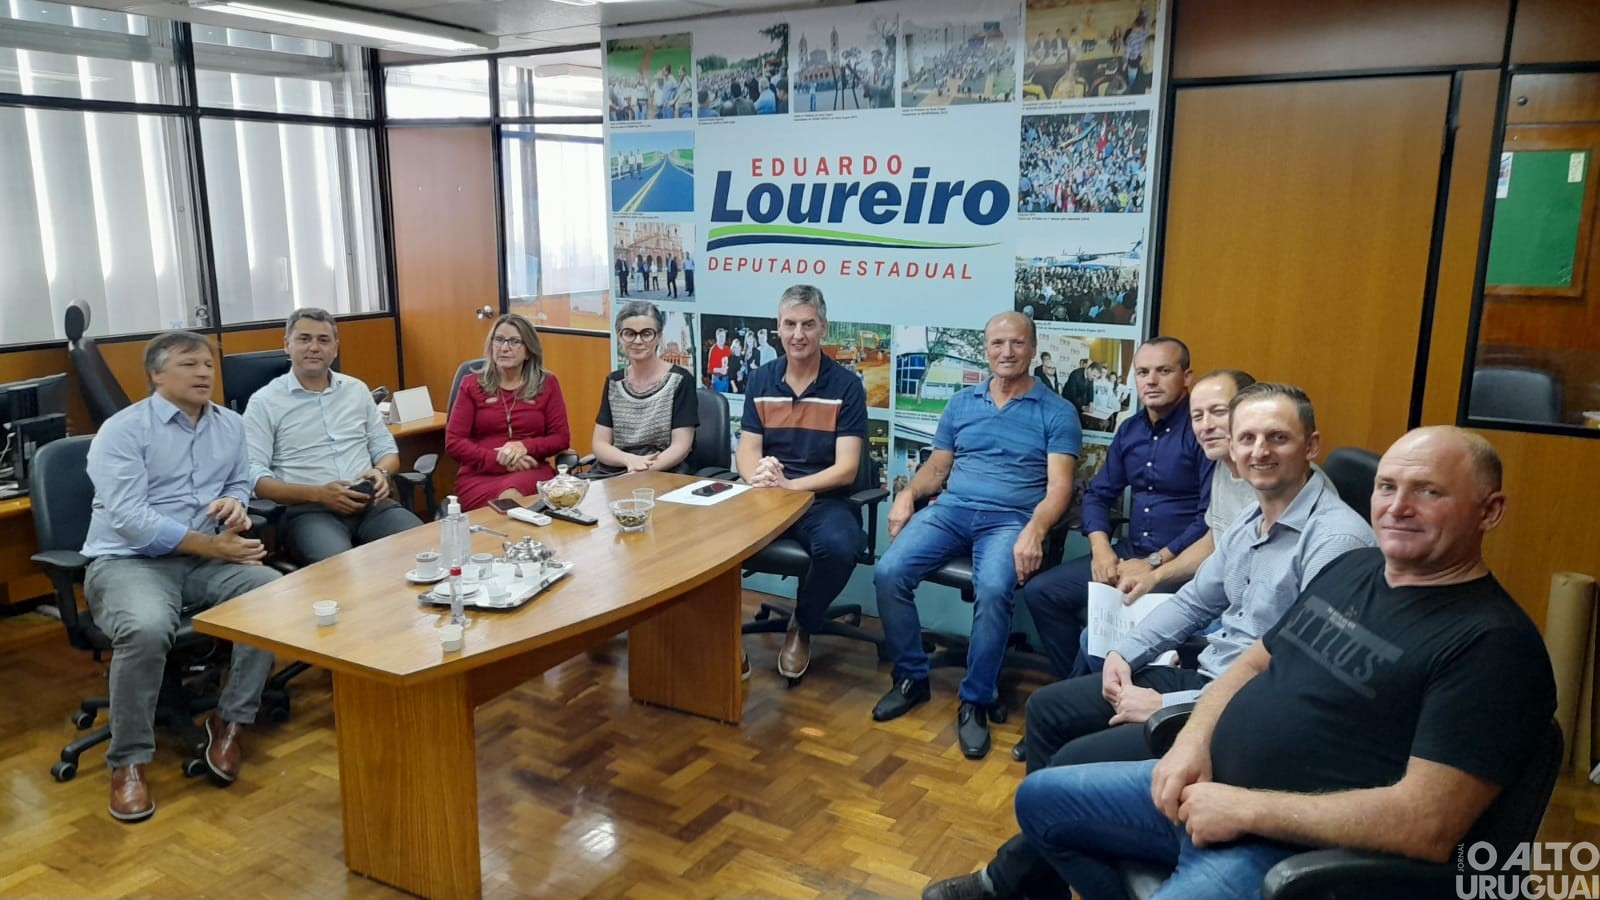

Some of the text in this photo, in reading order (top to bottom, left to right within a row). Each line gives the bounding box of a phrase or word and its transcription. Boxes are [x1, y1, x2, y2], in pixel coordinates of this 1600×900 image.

[751, 154, 903, 177] EDUARDO
[710, 166, 1011, 226] Loureiro
[707, 256, 973, 280] DEPUTADO ESTADUAL
